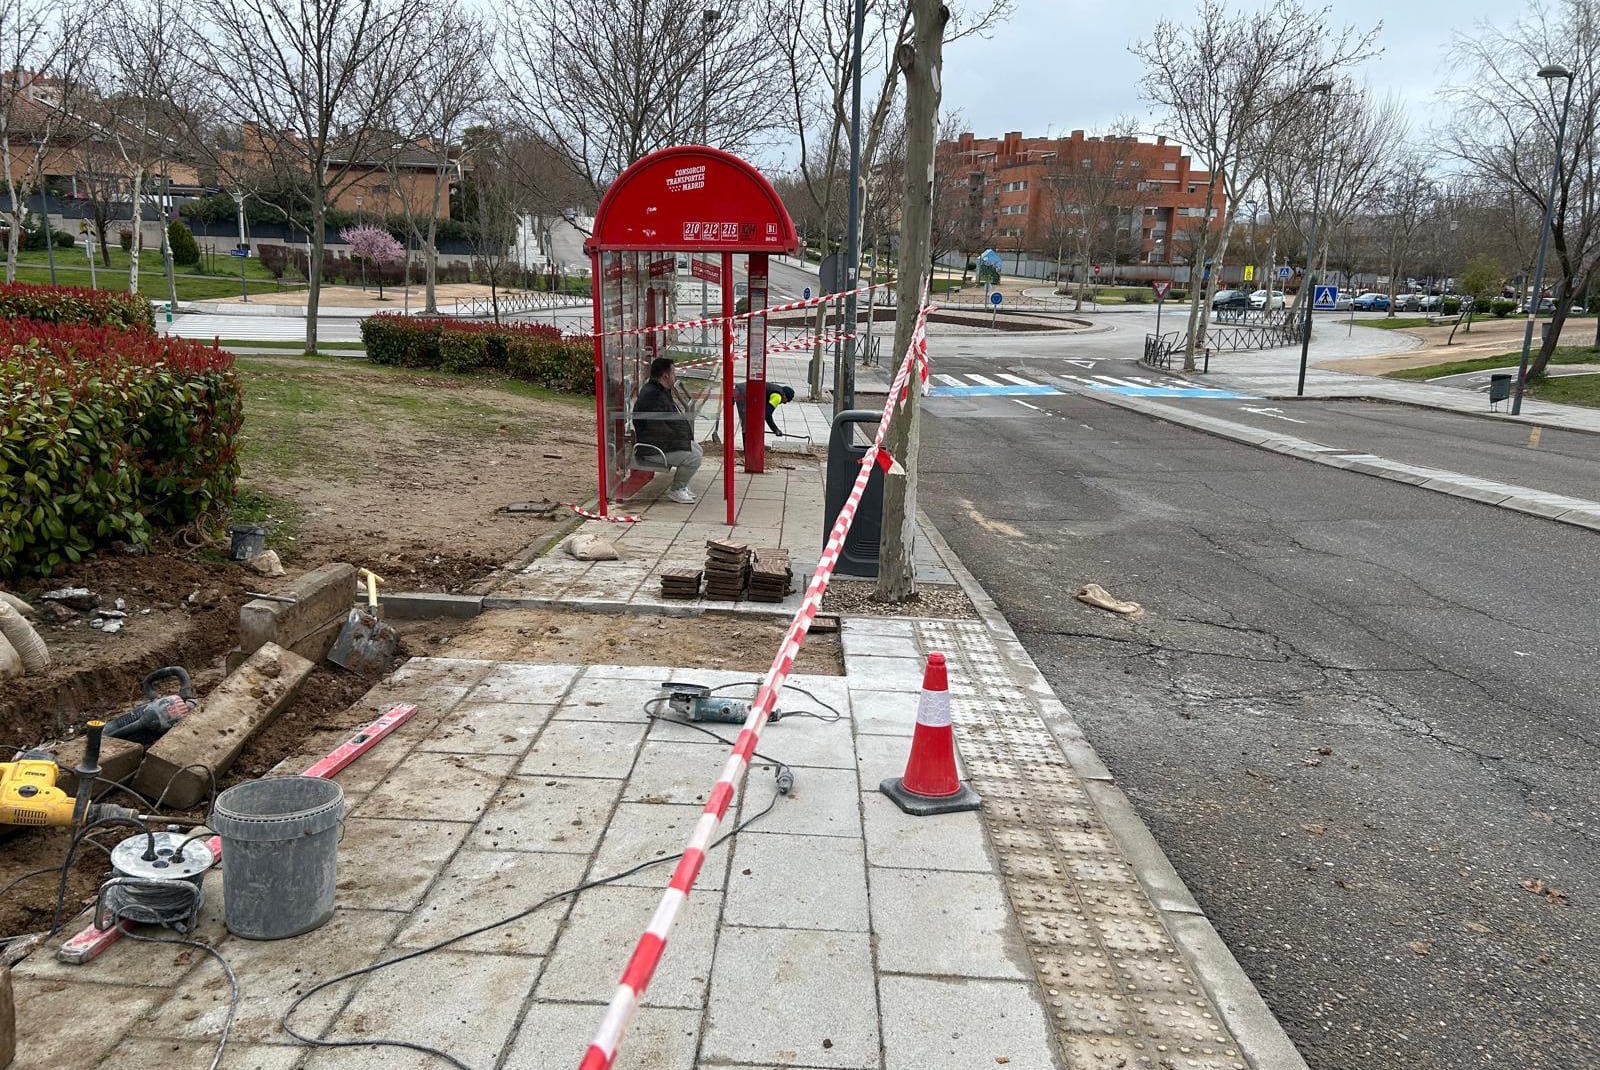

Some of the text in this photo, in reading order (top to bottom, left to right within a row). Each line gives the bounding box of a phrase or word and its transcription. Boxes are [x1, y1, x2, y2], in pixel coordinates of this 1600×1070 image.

[675, 165, 706, 177] CONSORCIO
[666, 173, 705, 186] TRANSPORTES
[682, 181, 705, 191] MADRID
[685, 223, 700, 234] 210
[703, 223, 719, 234] 212
[722, 224, 737, 234] 215
